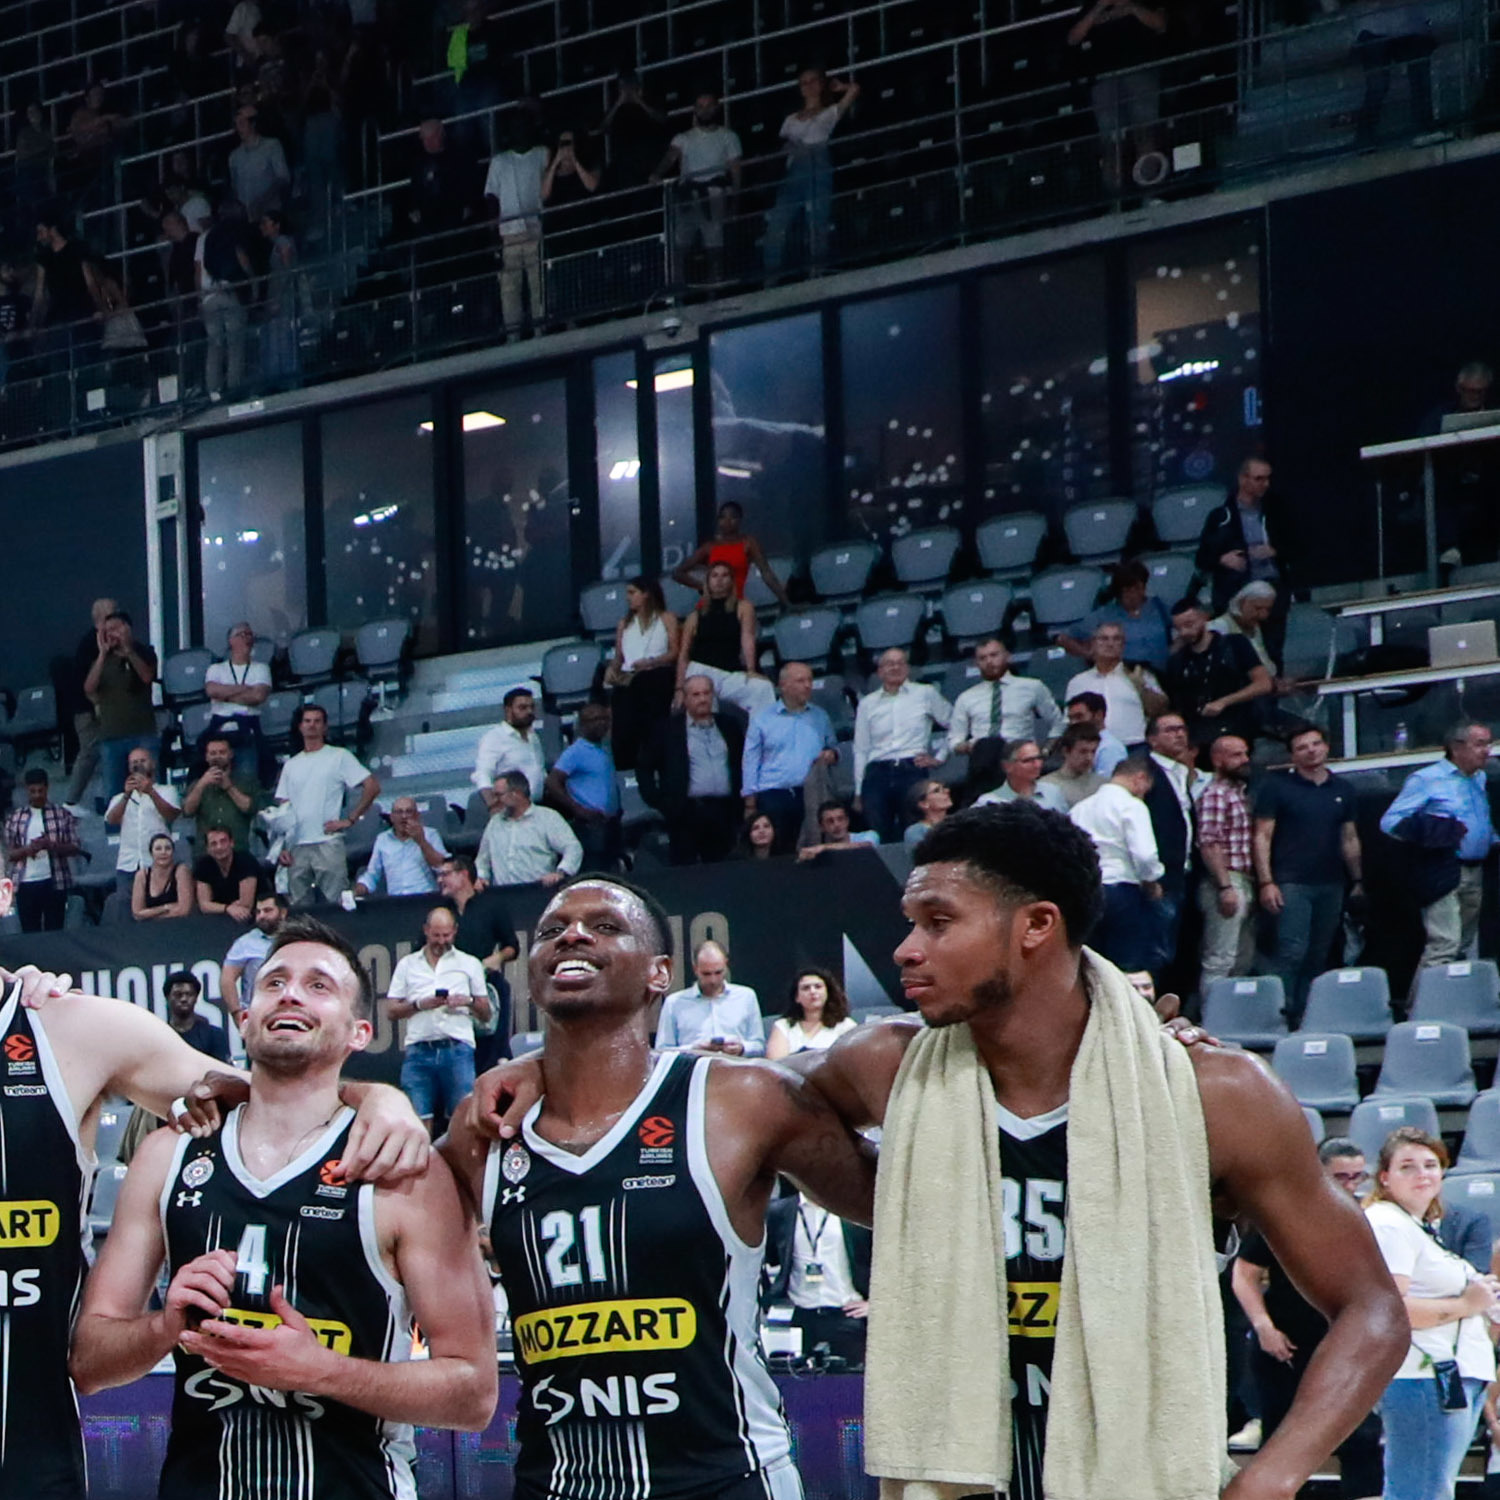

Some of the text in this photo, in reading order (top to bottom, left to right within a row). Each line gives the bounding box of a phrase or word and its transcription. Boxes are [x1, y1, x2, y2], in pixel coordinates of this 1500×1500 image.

[236, 1223, 270, 1295] 4
[541, 1204, 607, 1288] 21
[519, 1305, 687, 1354] MOZZART
[579, 1371, 680, 1417] NIS
